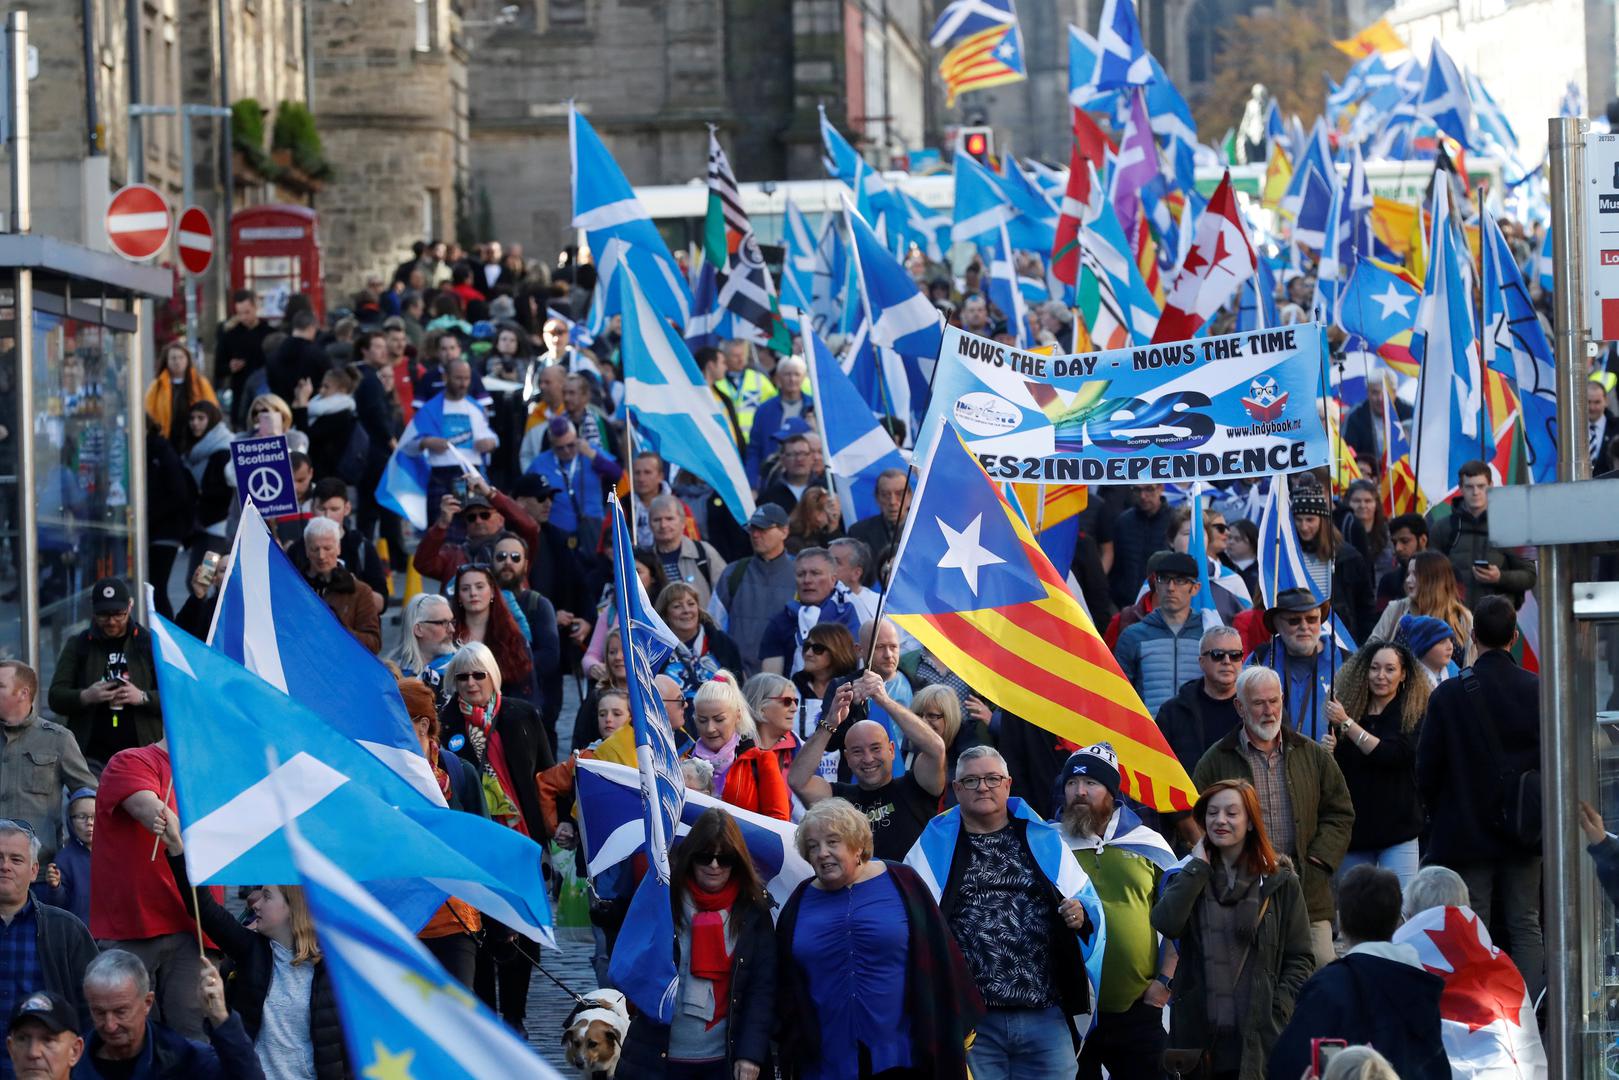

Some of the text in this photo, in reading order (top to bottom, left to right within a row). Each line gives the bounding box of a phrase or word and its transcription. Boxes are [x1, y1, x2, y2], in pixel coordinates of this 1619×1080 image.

[958, 335, 1005, 368] NOWS
[1010, 352, 1047, 378] THE
[1054, 356, 1098, 377] DAY
[1133, 344, 1196, 370] NOWS
[1201, 337, 1243, 361] THE
[1248, 329, 1297, 355] TIME
[1023, 379, 1216, 453] Yes
[237, 440, 282, 454] Respect
[1155, 436, 1184, 444] Freedom
[1187, 434, 1204, 442] Party
[237, 450, 285, 466] Scotland
[974, 440, 1309, 481] ES2INDEPENDENCE
